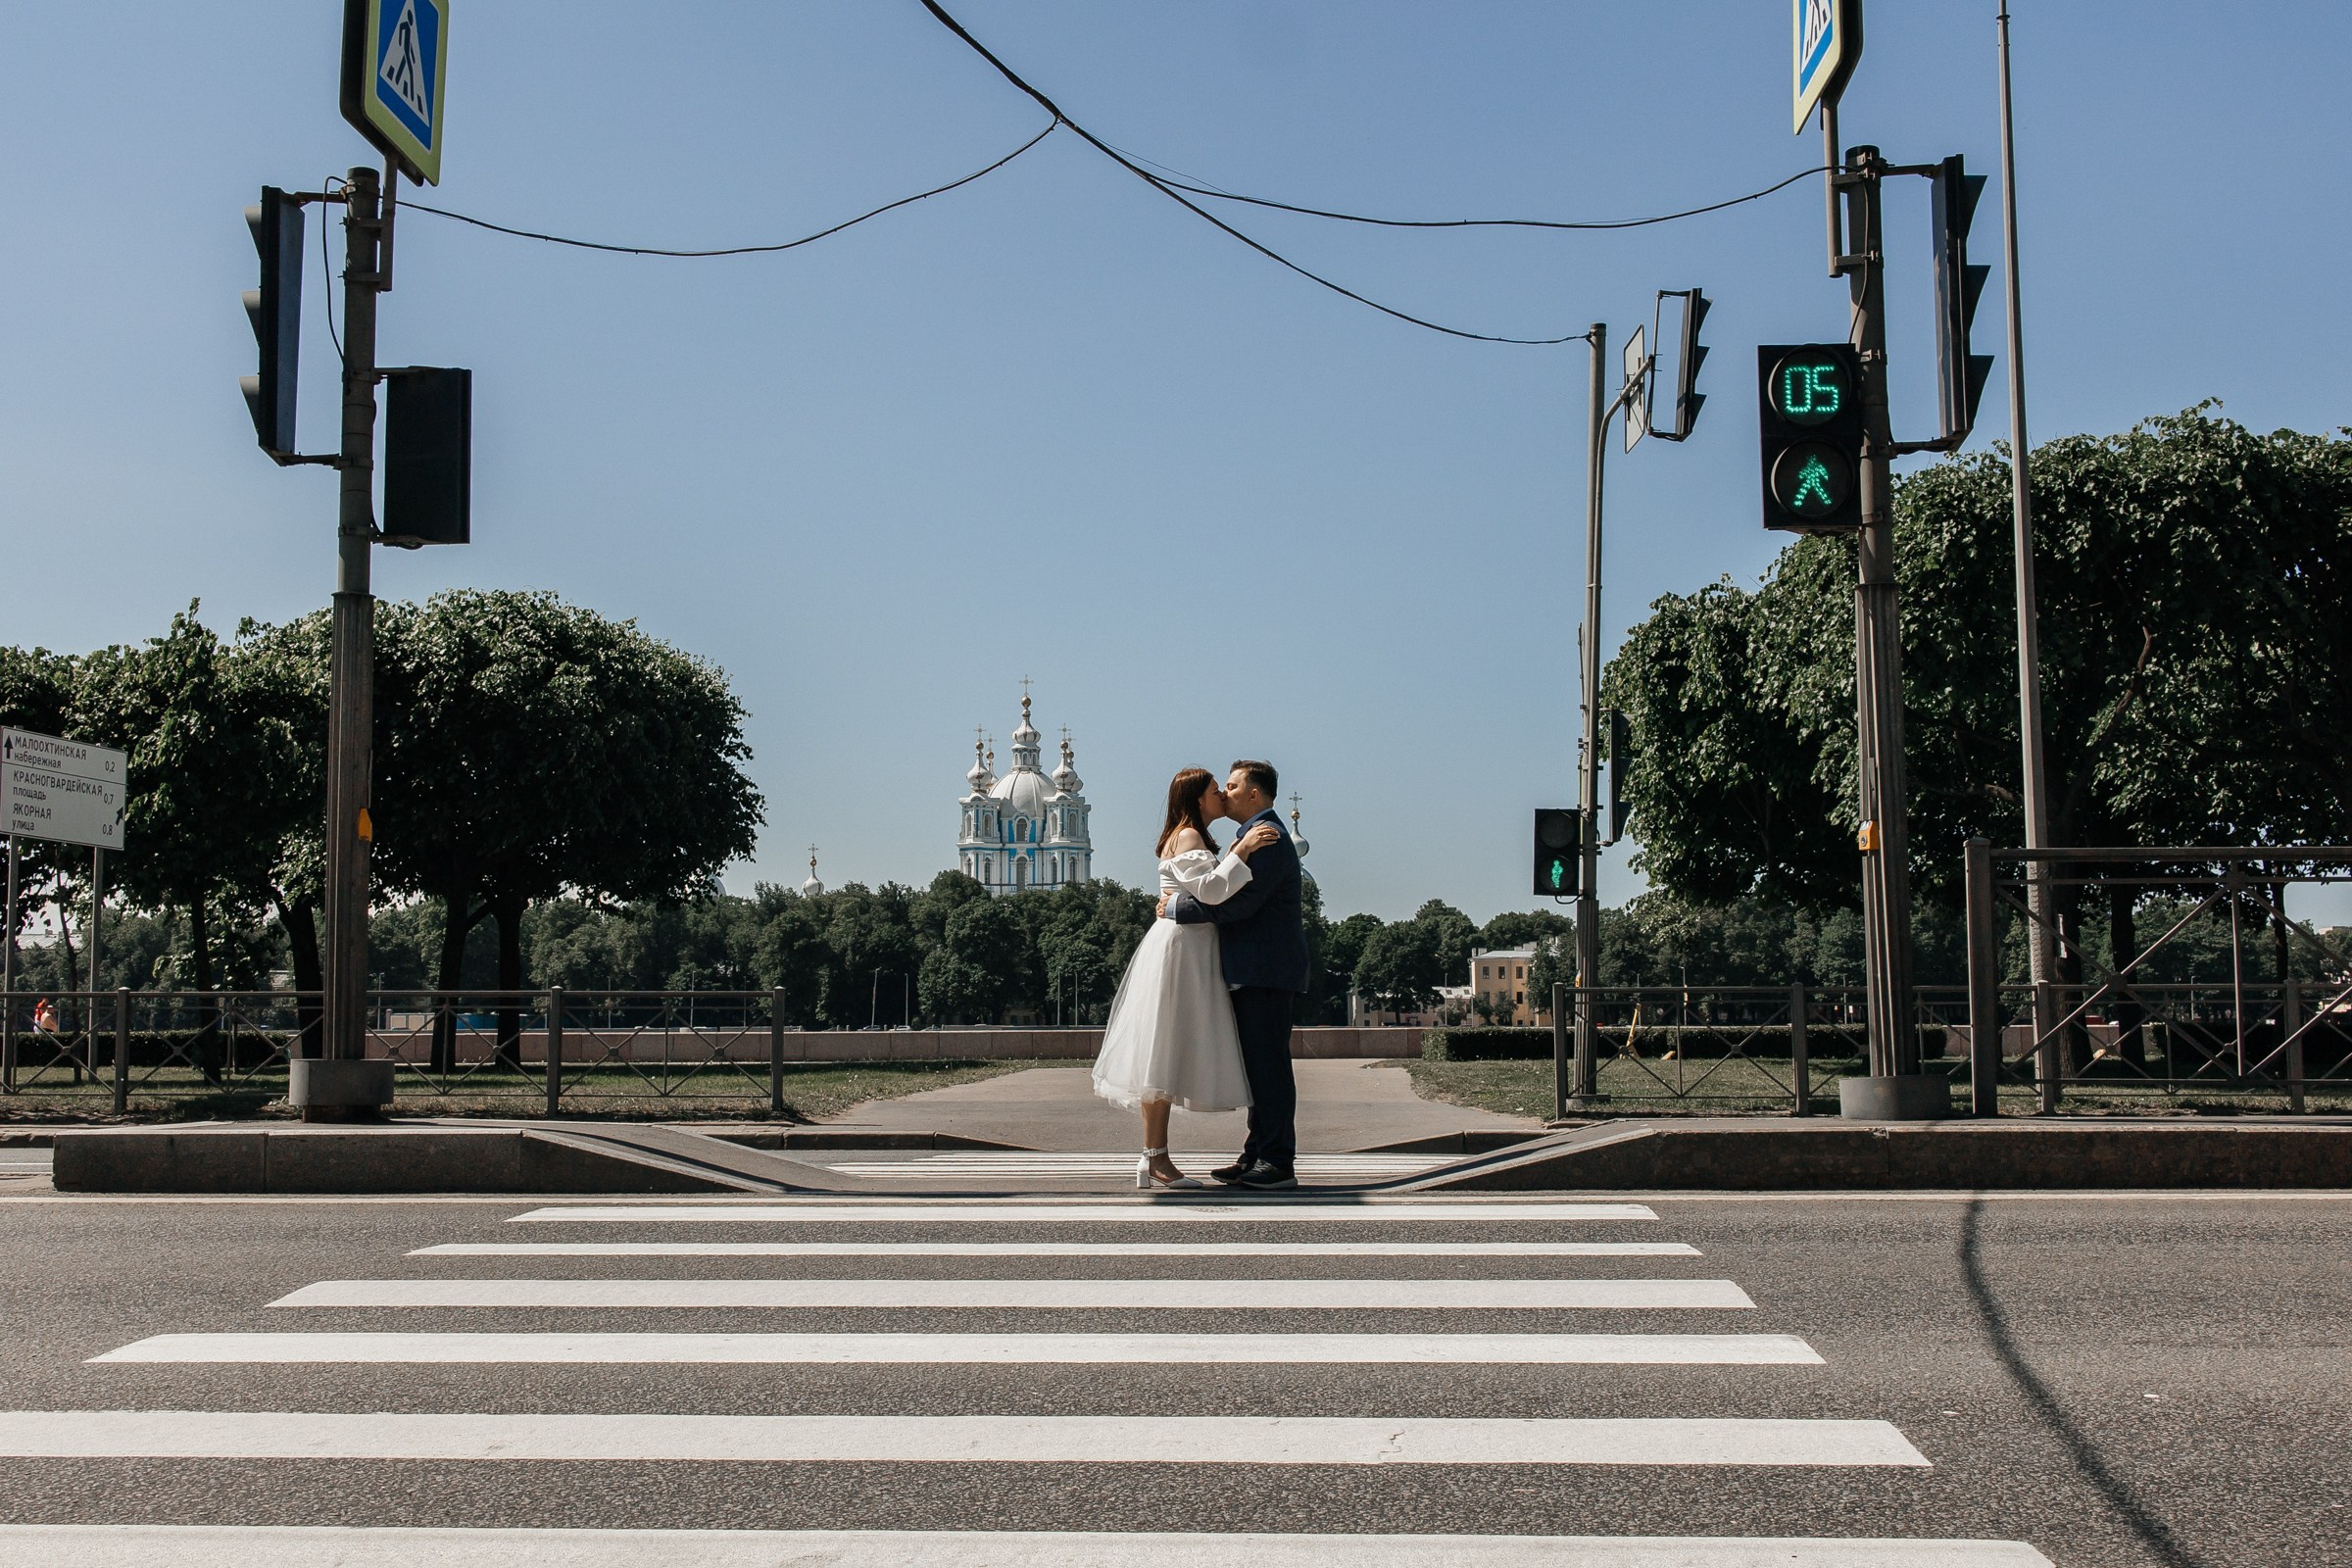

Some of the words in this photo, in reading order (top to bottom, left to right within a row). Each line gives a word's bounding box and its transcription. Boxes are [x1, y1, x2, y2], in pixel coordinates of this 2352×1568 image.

[1785, 366, 1838, 413] 05
[15, 736, 86, 760] МАЛООХТИНСКАЯ
[14, 751, 62, 769] набережная
[105, 760, 116, 772] 0,2
[14, 770, 103, 797] КРАСНОГВАРДЕЙСКАЯ
[13, 787, 47, 801] площадь
[103, 793, 115, 806] 0,7
[13, 804, 52, 820] ЯКОРНАЯ
[12, 819, 35, 831] улица
[102, 824, 114, 836] 0,8
